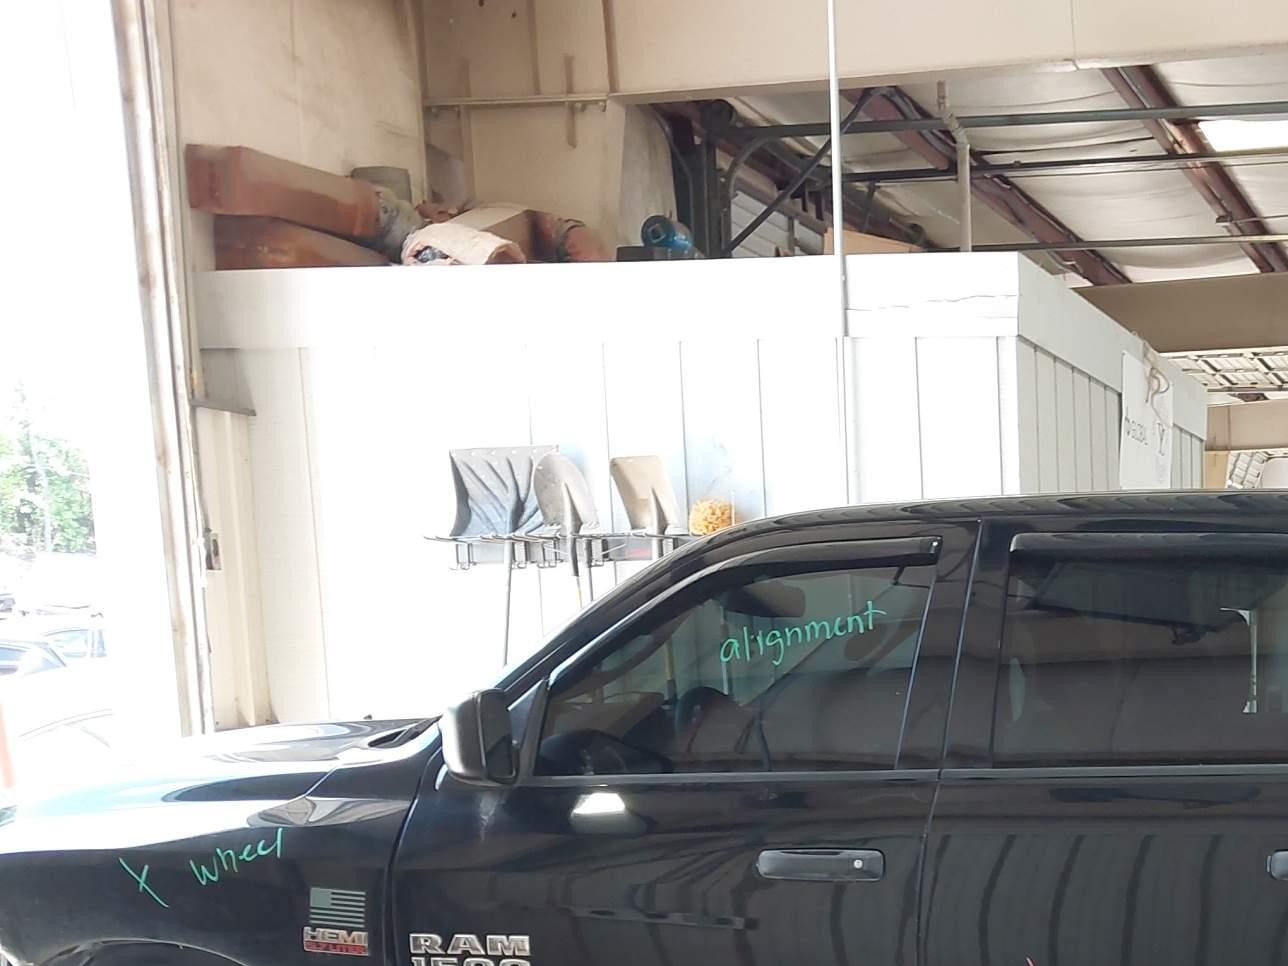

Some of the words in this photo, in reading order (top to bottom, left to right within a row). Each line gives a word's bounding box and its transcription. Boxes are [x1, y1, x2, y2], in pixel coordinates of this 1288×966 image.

[720, 600, 887, 666] alignment
[304, 926, 368, 944] HEMI
[409, 933, 531, 956] RAM
